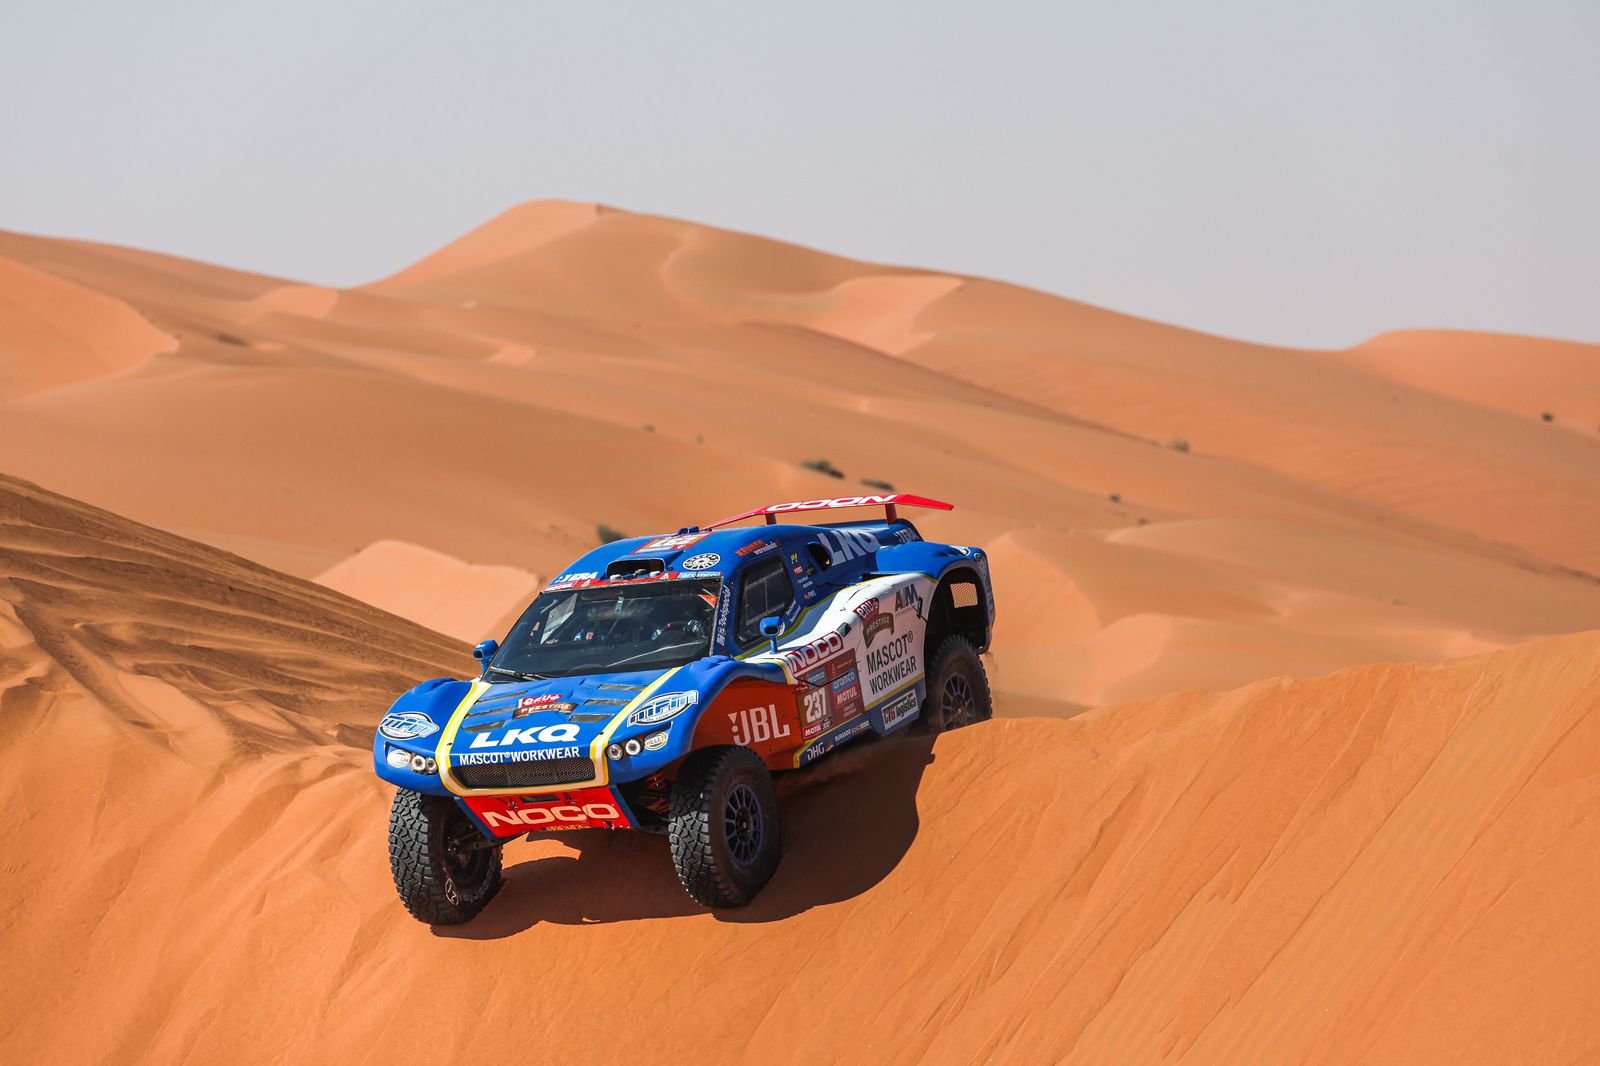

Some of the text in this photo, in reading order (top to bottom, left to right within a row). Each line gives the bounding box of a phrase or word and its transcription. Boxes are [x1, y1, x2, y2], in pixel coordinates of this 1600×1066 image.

[817, 528, 881, 566] LKQ
[787, 633, 842, 673] NOCO
[869, 656, 917, 695] WORKWEAR
[520, 702, 573, 714] PRESTIGE
[804, 687, 827, 723] 237
[836, 686, 858, 705] MOTUL
[896, 694, 917, 718] logistics
[469, 723, 580, 748] LKQ
[731, 704, 790, 746] JBL
[806, 742, 826, 761] DHG
[482, 803, 620, 827] NOCO
